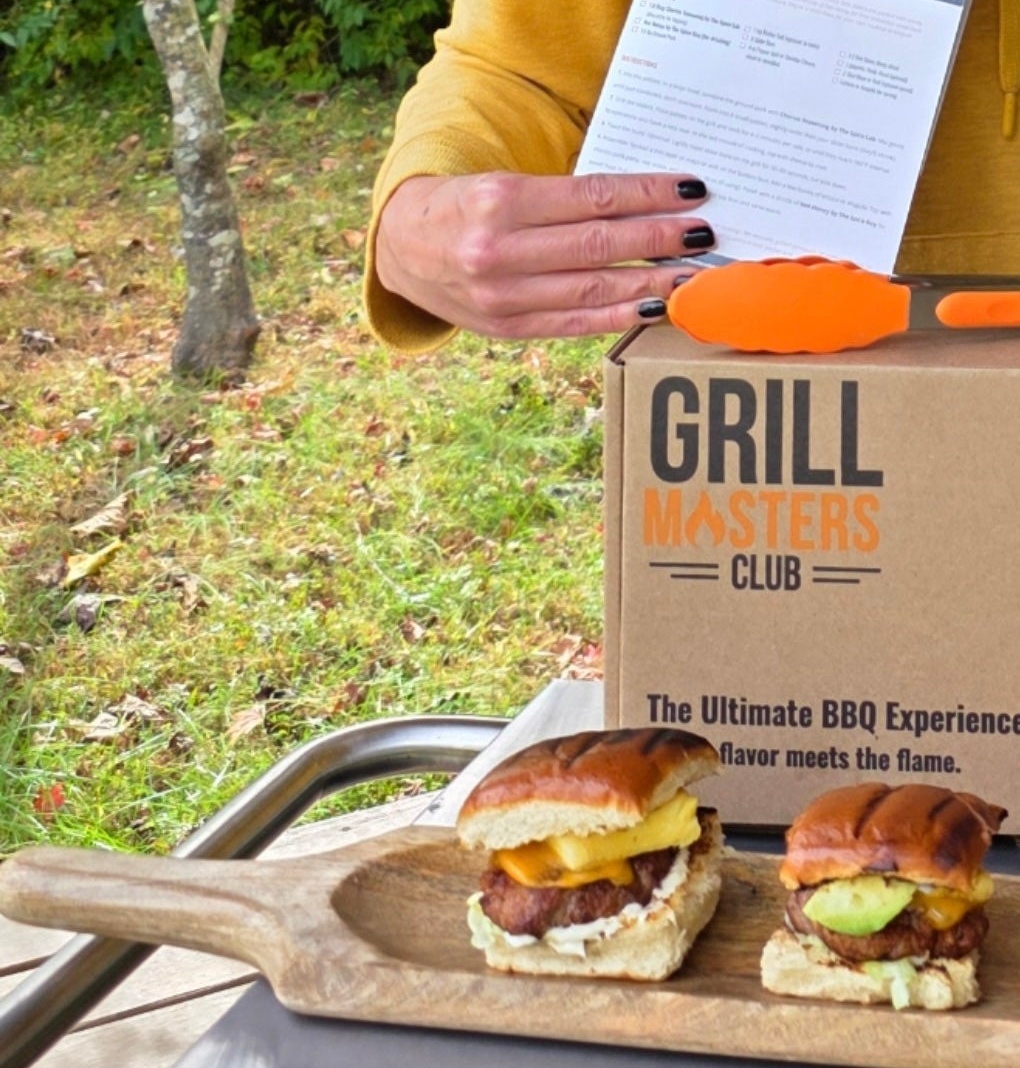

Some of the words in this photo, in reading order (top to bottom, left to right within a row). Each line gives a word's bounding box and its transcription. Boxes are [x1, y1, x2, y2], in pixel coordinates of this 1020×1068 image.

[651, 376, 884, 487] GRILL
[731, 553, 801, 591] CLUB
[647, 694, 692, 723] The
[701, 695, 812, 727] Ultimate
[821, 699, 877, 734] BBQ
[719, 742, 779, 767] flavor
[786, 746, 849, 770] meets
[856, 746, 890, 770] the
[897, 748, 962, 774] flame.
